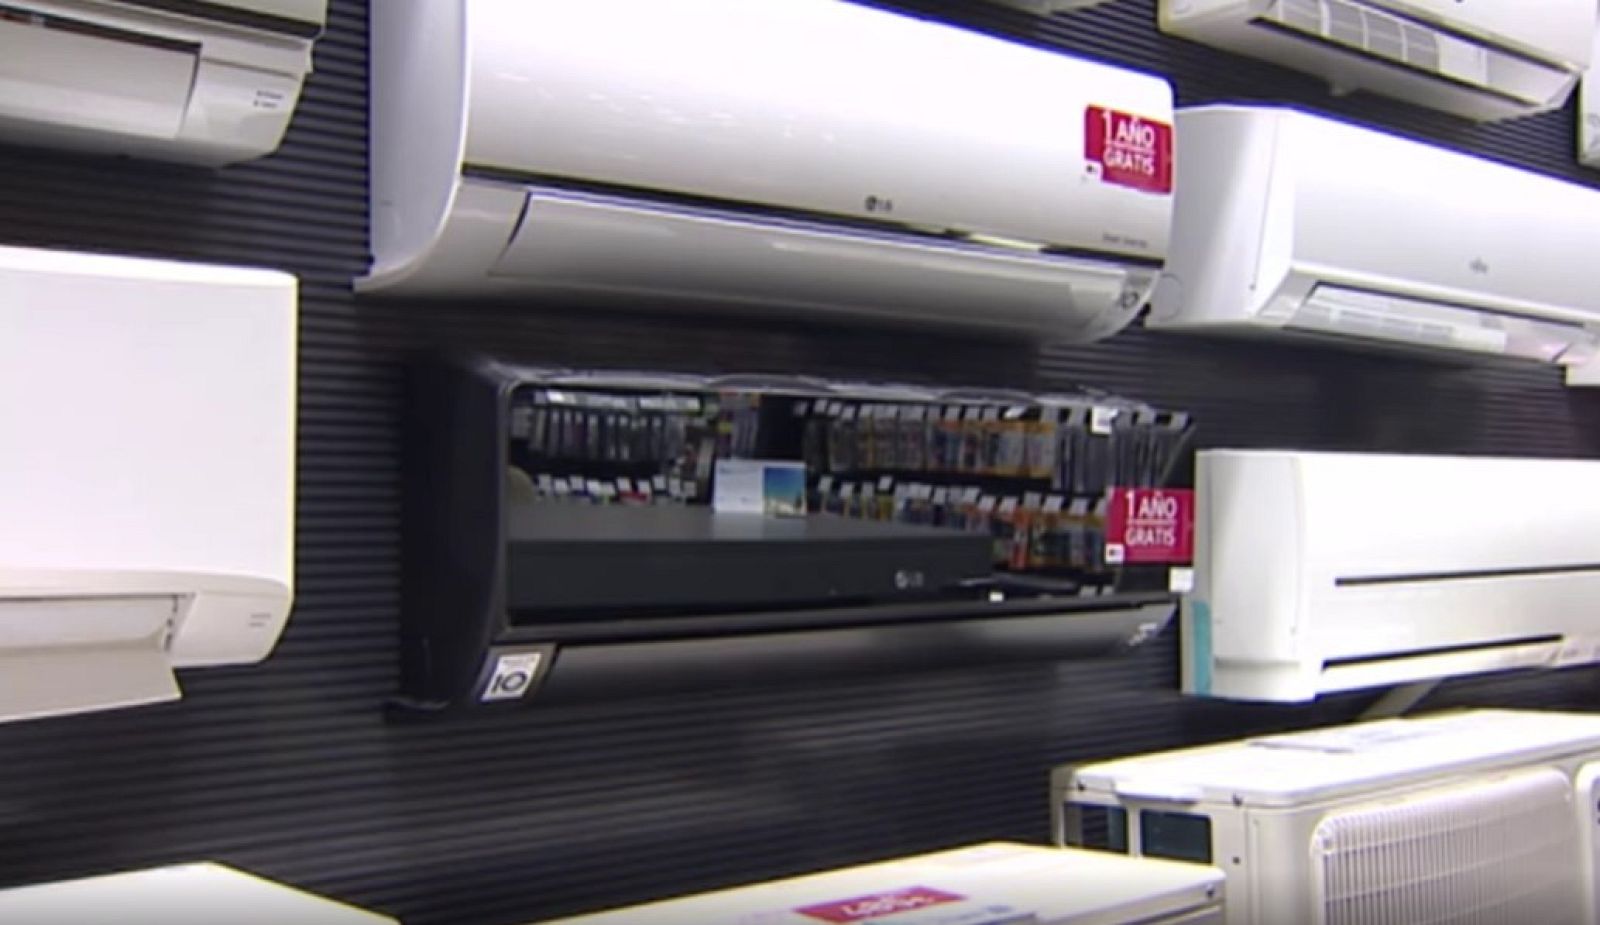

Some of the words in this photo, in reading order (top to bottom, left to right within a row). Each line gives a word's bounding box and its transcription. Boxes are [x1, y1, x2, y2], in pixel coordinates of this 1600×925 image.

[1102, 110, 1112, 144] 1
[1115, 115, 1155, 148] AÑO
[1103, 147, 1154, 175] GRATIS
[1126, 489, 1135, 518] 1
[1138, 491, 1177, 519] AÑO
[1125, 526, 1175, 547] GRATIS
